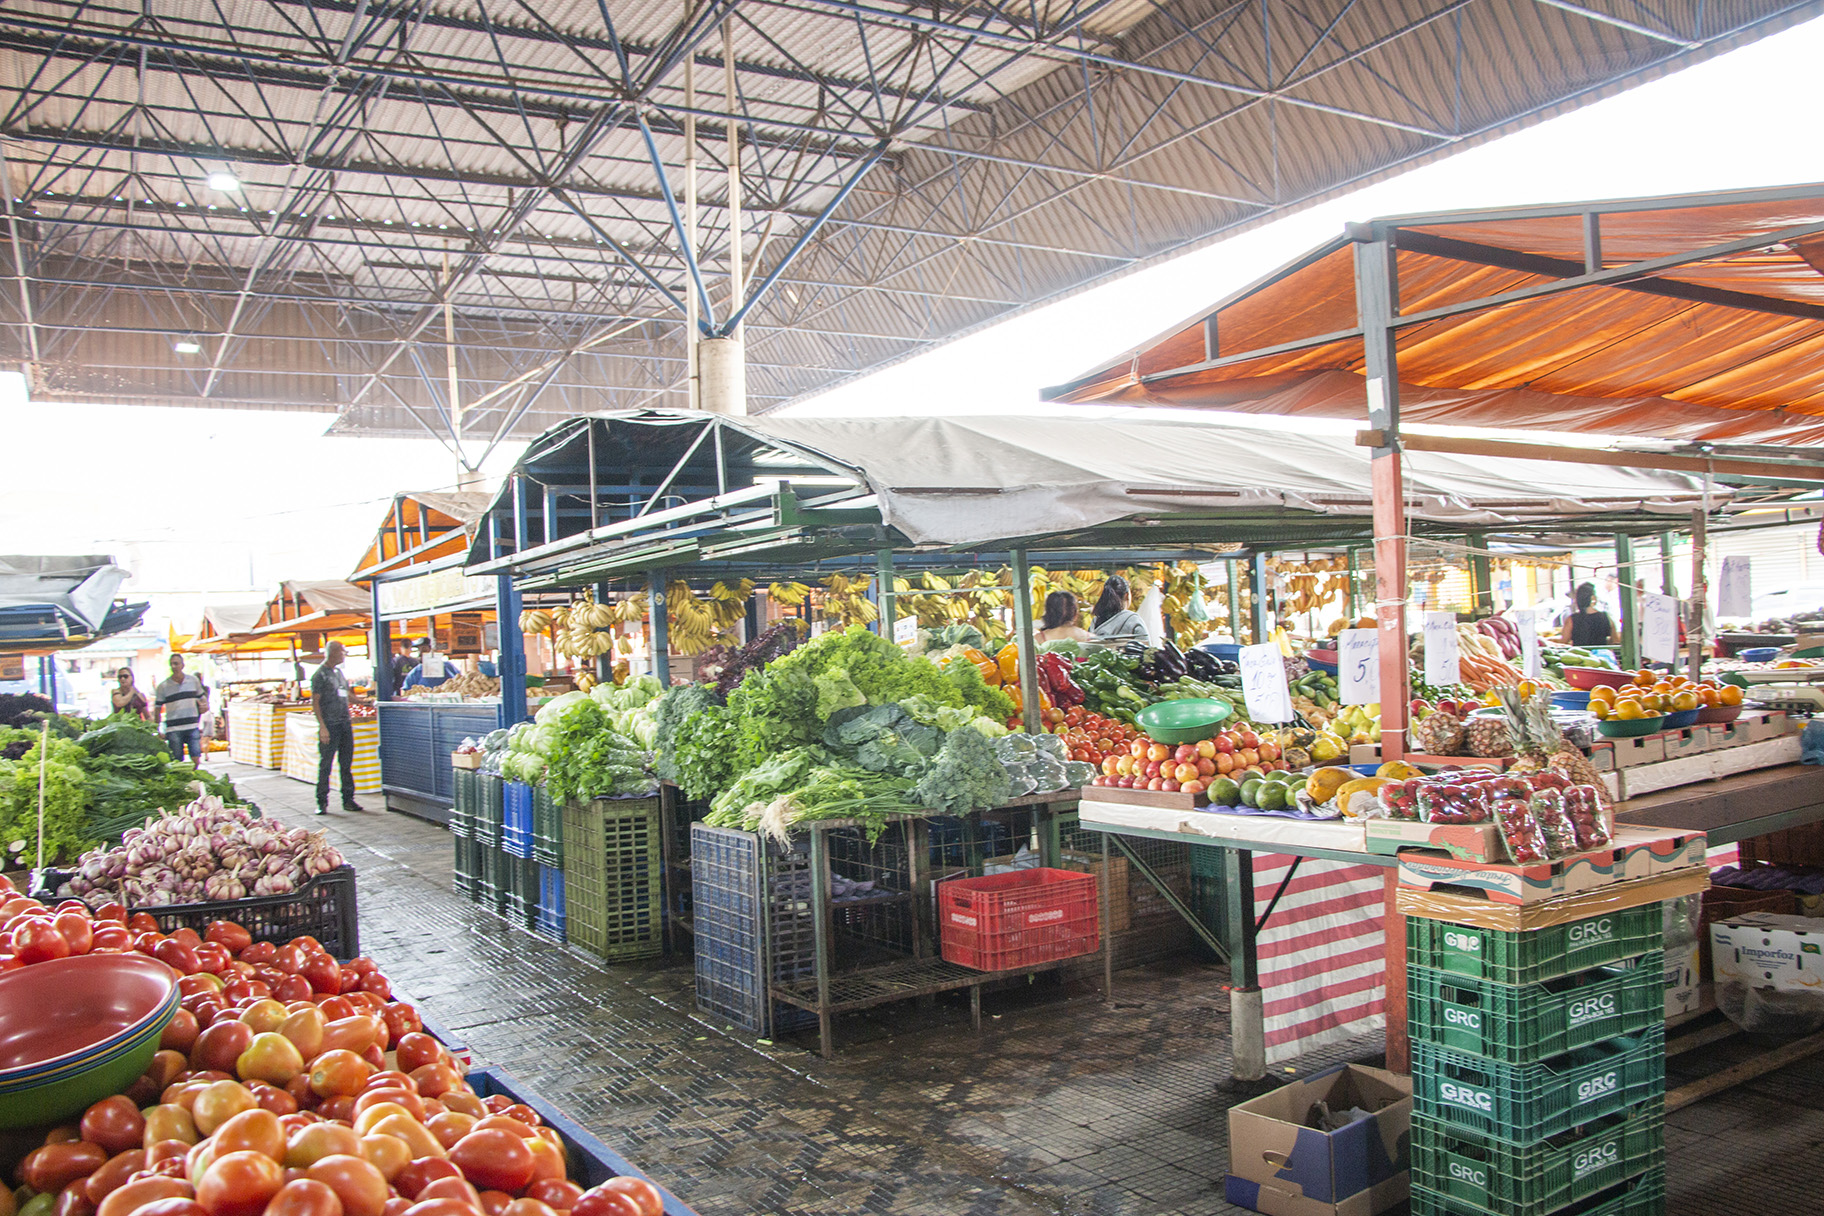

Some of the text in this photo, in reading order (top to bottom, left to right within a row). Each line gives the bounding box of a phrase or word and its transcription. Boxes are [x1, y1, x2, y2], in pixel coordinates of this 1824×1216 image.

[1405, 861, 1512, 887] Frutas Selecionadas
[1569, 918, 1612, 941] GRC
[1444, 1007, 1480, 1029] GRC
[1569, 994, 1614, 1018] GRC
[1440, 1082, 1492, 1107] GRC
[1578, 1071, 1617, 1097] GRC
[1574, 1142, 1617, 1170] GRC
[1450, 1162, 1486, 1187] GRC
